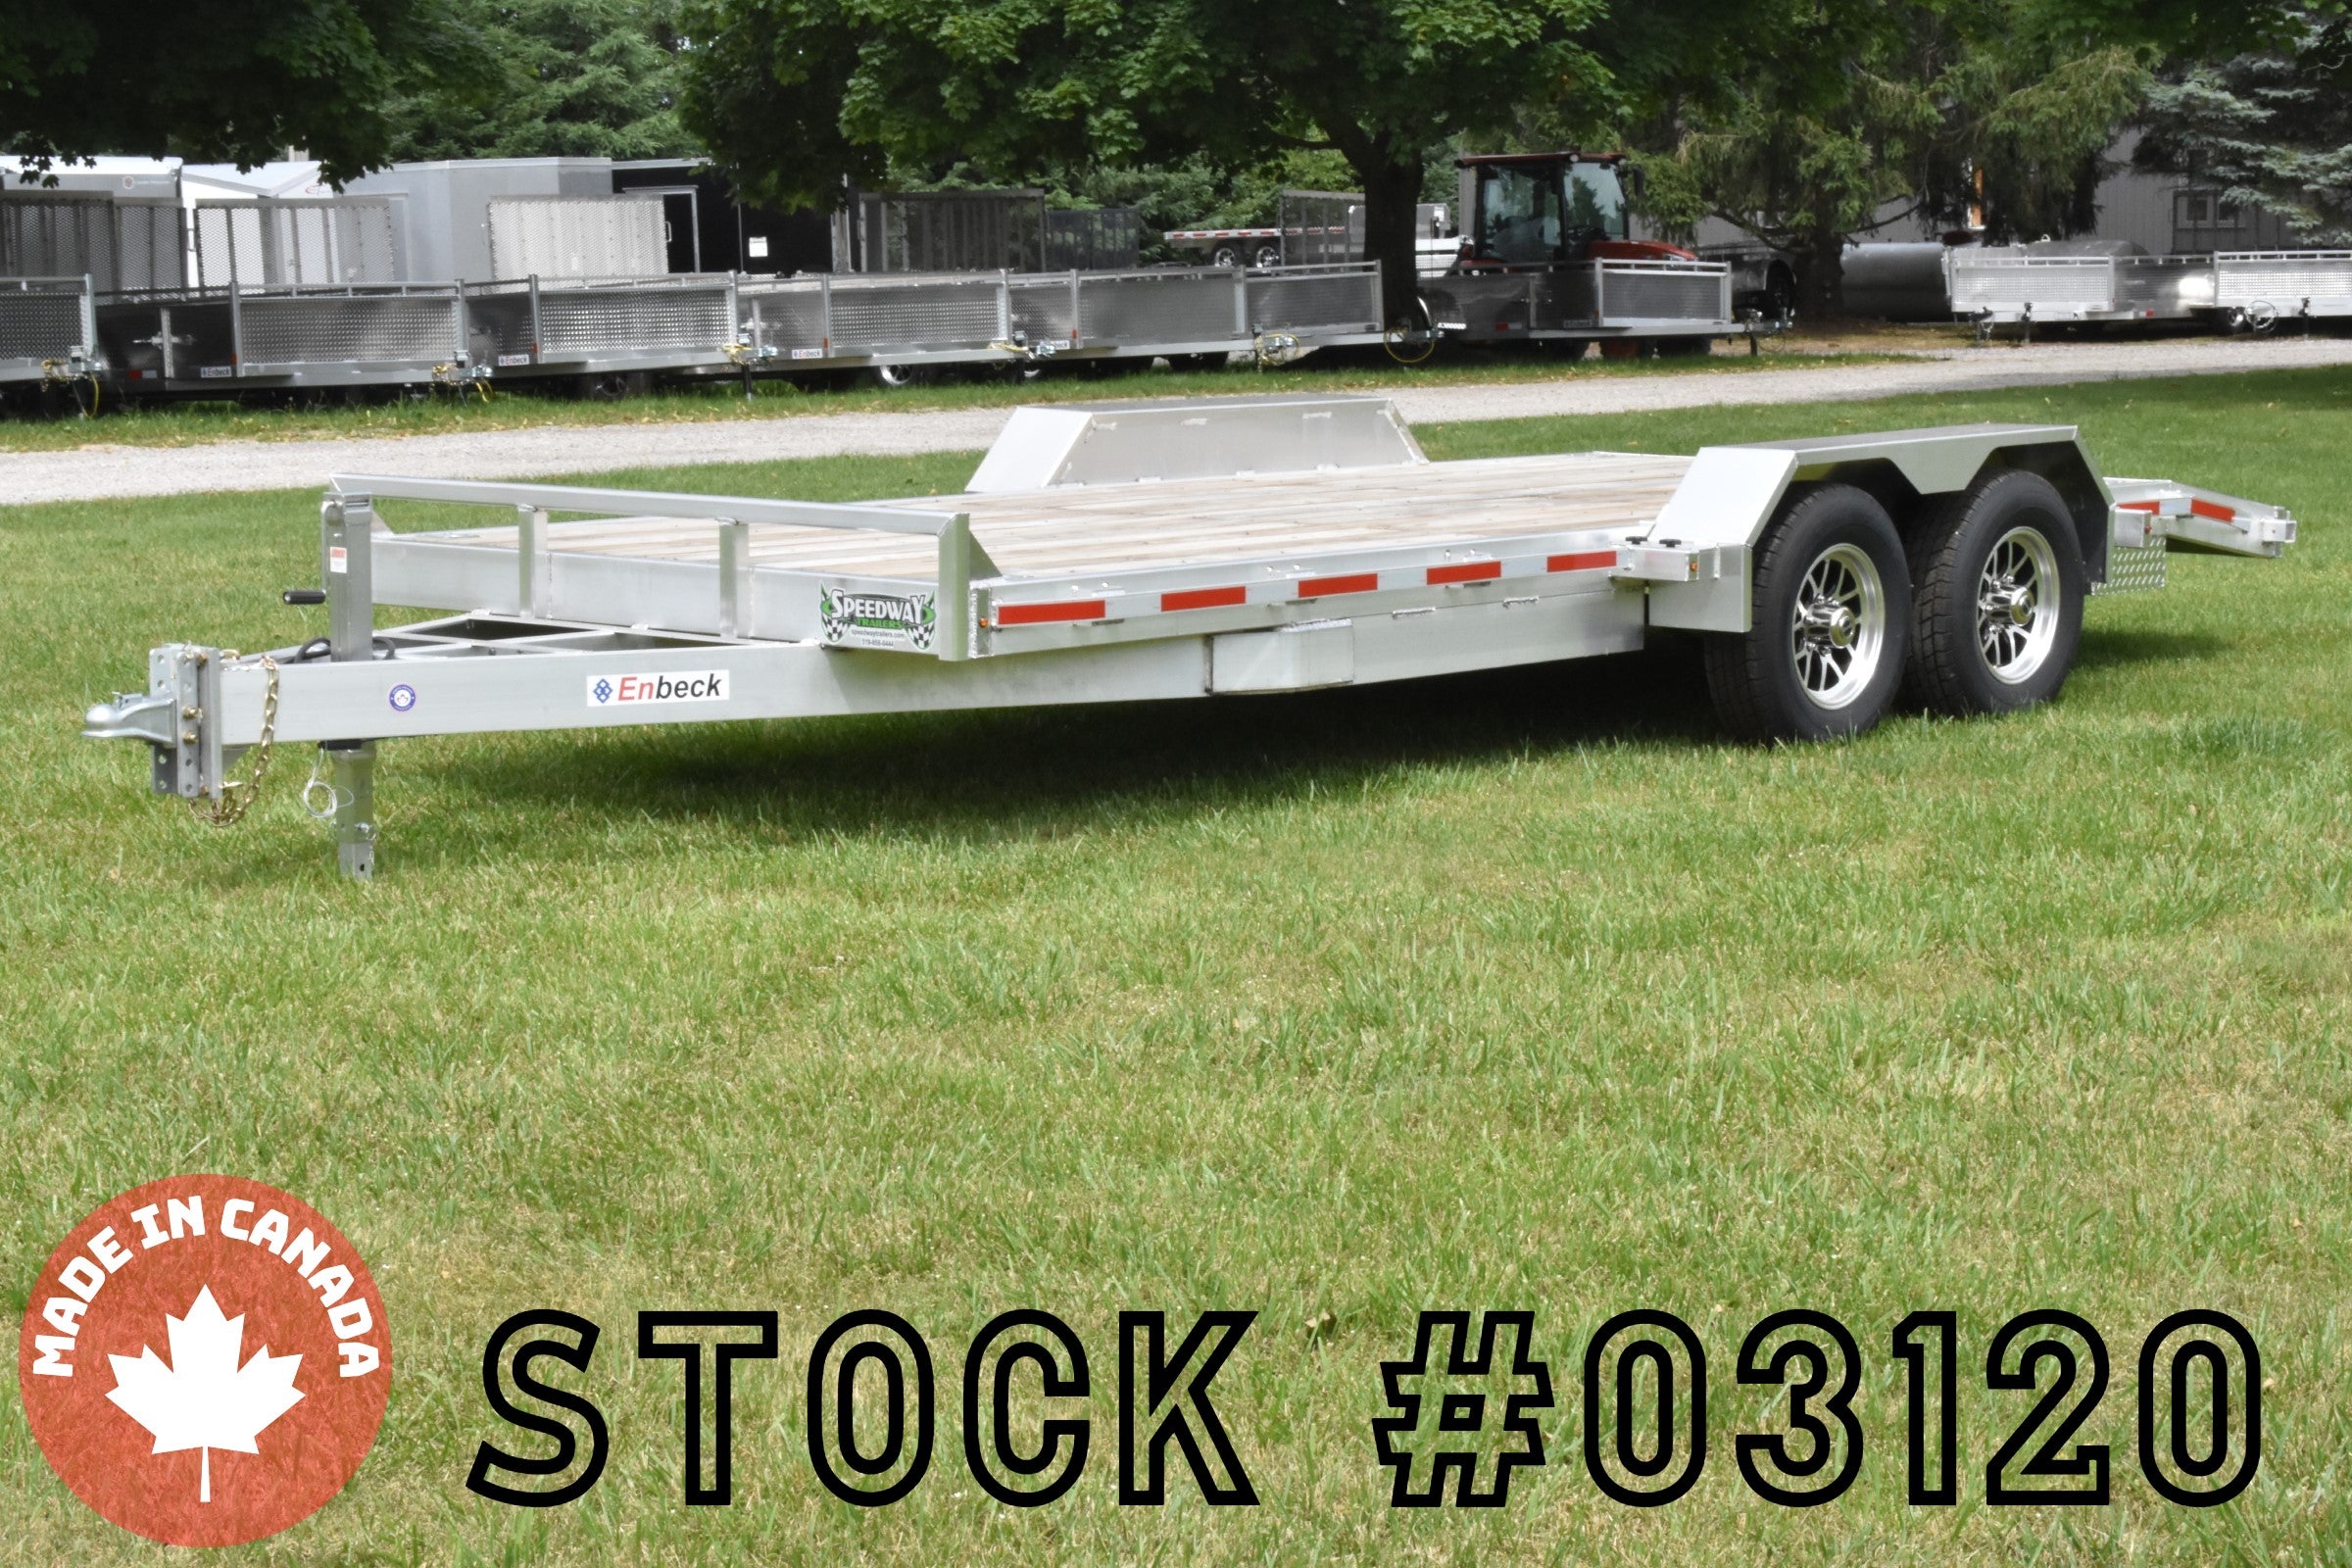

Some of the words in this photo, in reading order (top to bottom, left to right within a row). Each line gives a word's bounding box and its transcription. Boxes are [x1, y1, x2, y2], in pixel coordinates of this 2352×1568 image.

[830, 589, 925, 625] SPEEDWAY
[856, 618, 903, 629] TRAILERS
[617, 673, 722, 701] Enbeck
